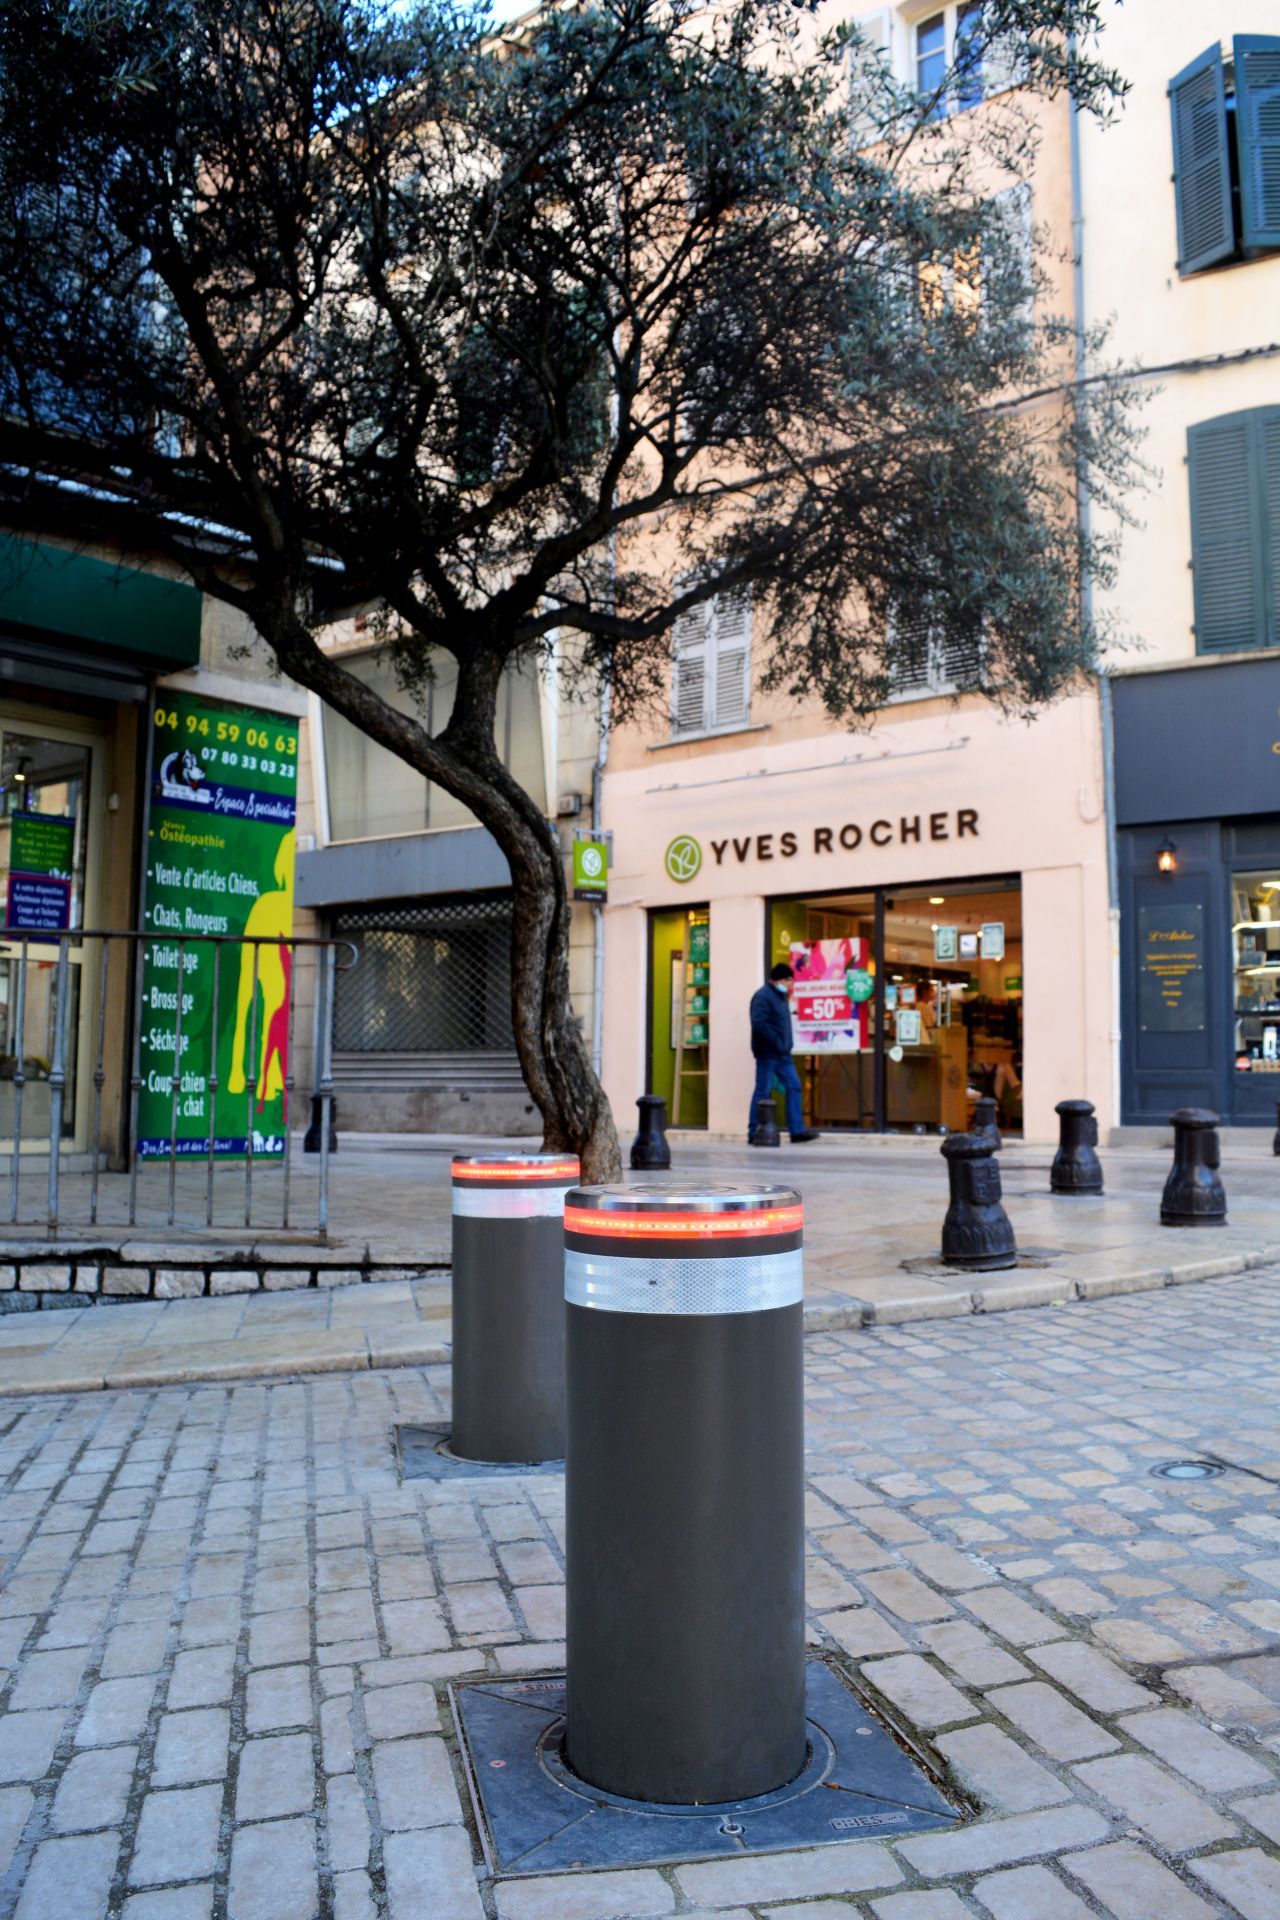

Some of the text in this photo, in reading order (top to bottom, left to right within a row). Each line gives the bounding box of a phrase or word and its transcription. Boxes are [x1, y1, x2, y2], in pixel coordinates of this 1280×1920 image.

[154, 708, 297, 755] 04 94 59 06 63
[201, 747, 295, 778] 07 80 33 03 23
[160, 827, 225, 848] Ostéopathie
[710, 808, 979, 865] YVES ROCHER
[155, 862, 260, 896] Vente d'articles Chiens,
[153, 903, 228, 935] Chats, Rongeurs
[151, 986, 194, 1015] Brossge
[804, 998, 845, 1019] -50%
[148, 1070, 206, 1097] Coup chien
[184, 1095, 204, 1117] chat
